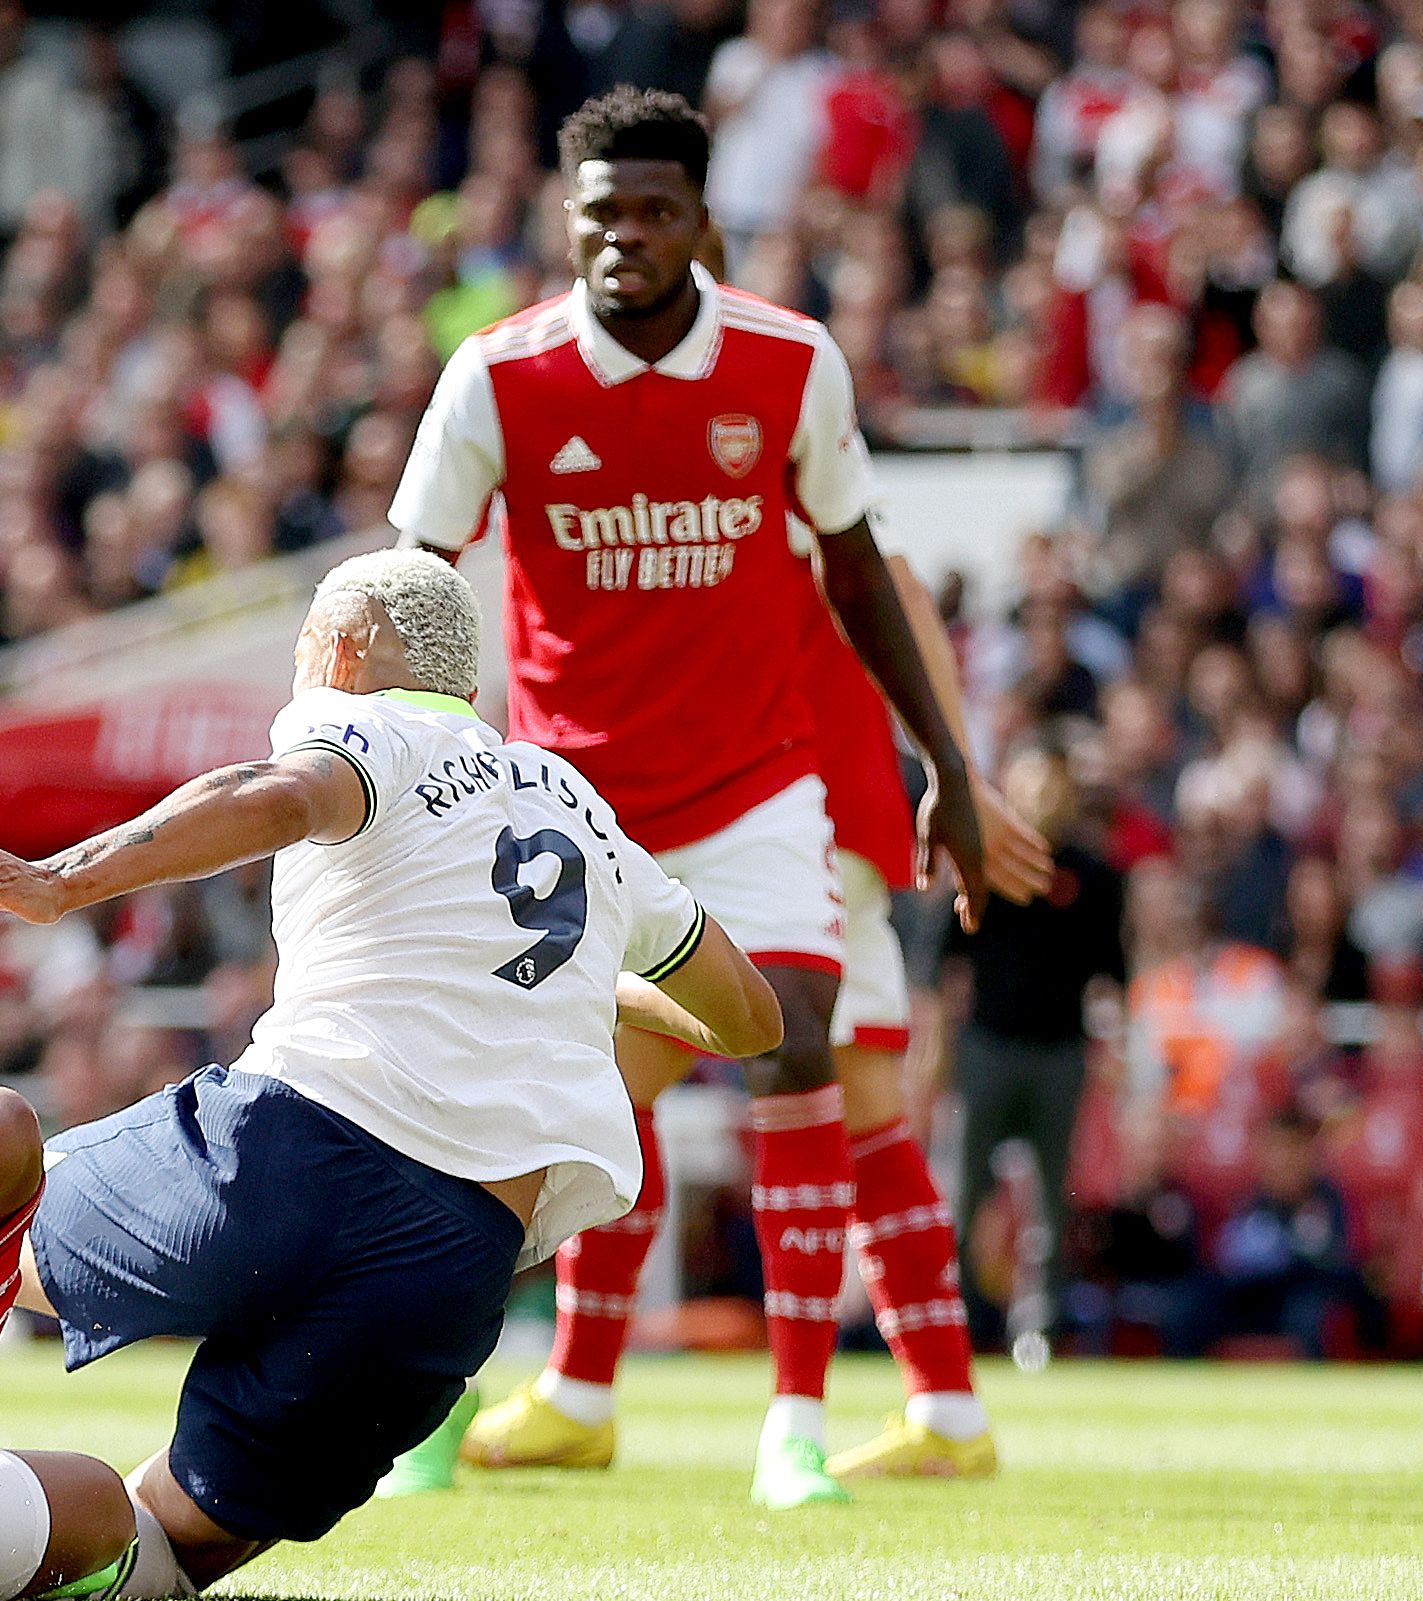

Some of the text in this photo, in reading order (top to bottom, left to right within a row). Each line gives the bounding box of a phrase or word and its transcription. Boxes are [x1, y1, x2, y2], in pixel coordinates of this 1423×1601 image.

[545, 492, 764, 551] Emirates
[586, 542, 737, 591] FLY BETTER
[491, 824, 587, 990] 9
